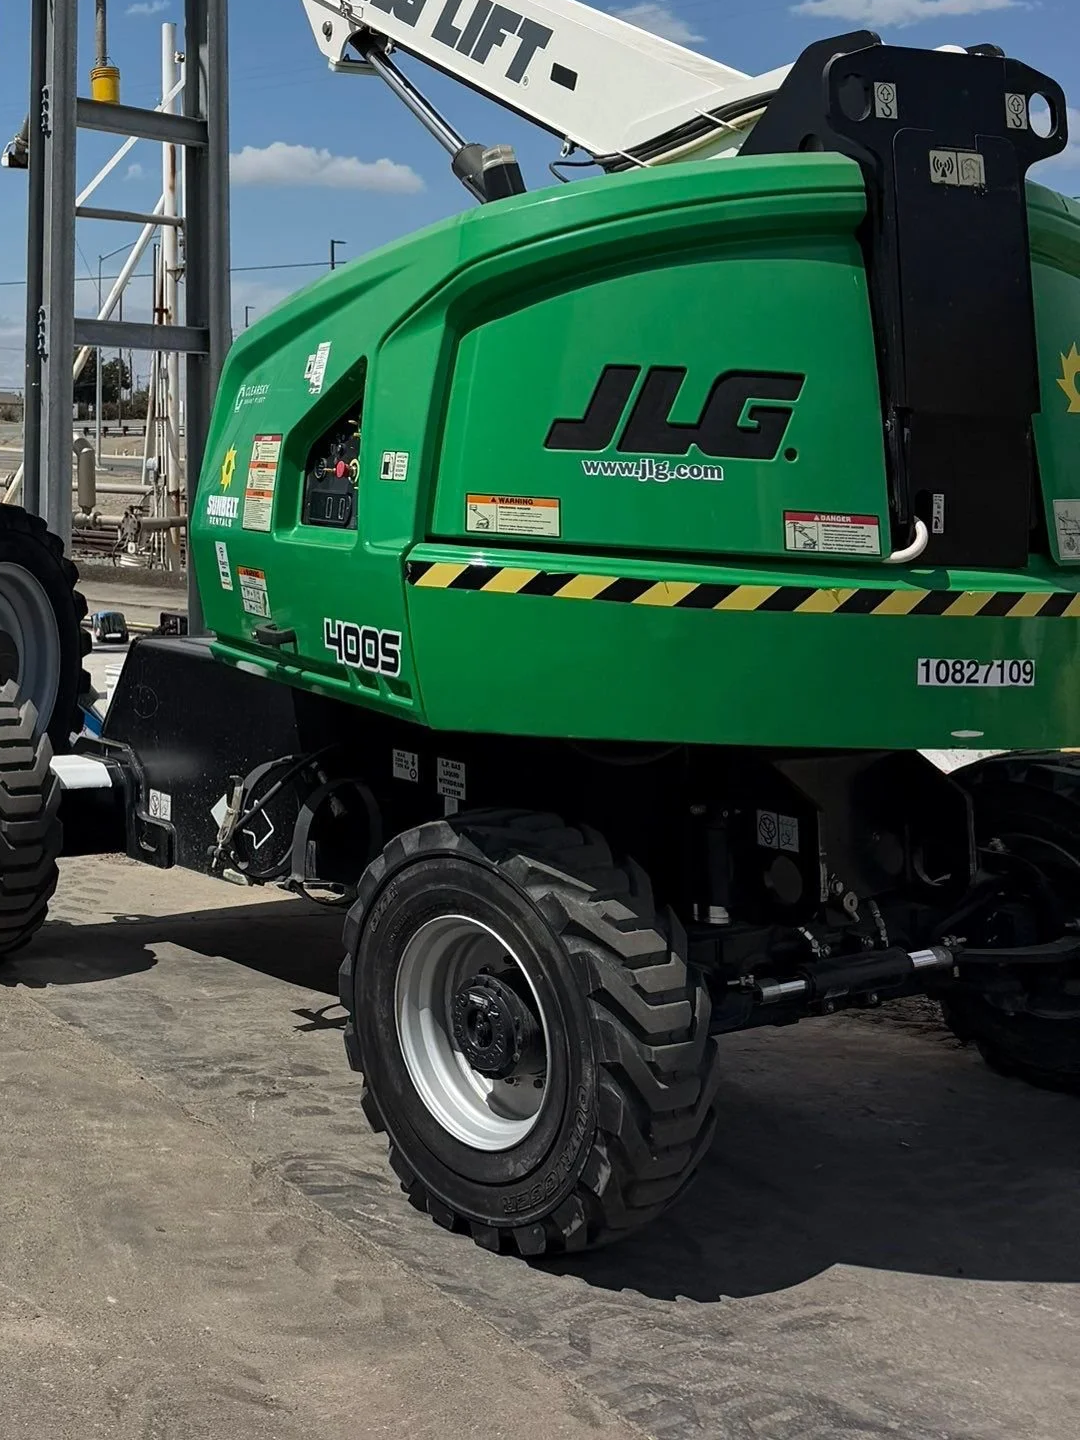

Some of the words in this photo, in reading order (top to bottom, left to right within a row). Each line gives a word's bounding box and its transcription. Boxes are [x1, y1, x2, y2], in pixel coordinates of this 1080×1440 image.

[543, 363, 807, 461] JLG
[582, 459, 724, 483] www.jlg.com
[207, 495, 239, 519] SUNBELT
[498, 497, 534, 506] WARNING
[209, 516, 232, 528] RENTALS
[820, 515, 852, 523] DANGER
[324, 617, 402, 678] 400S
[921, 659, 1034, 684] 10827109
